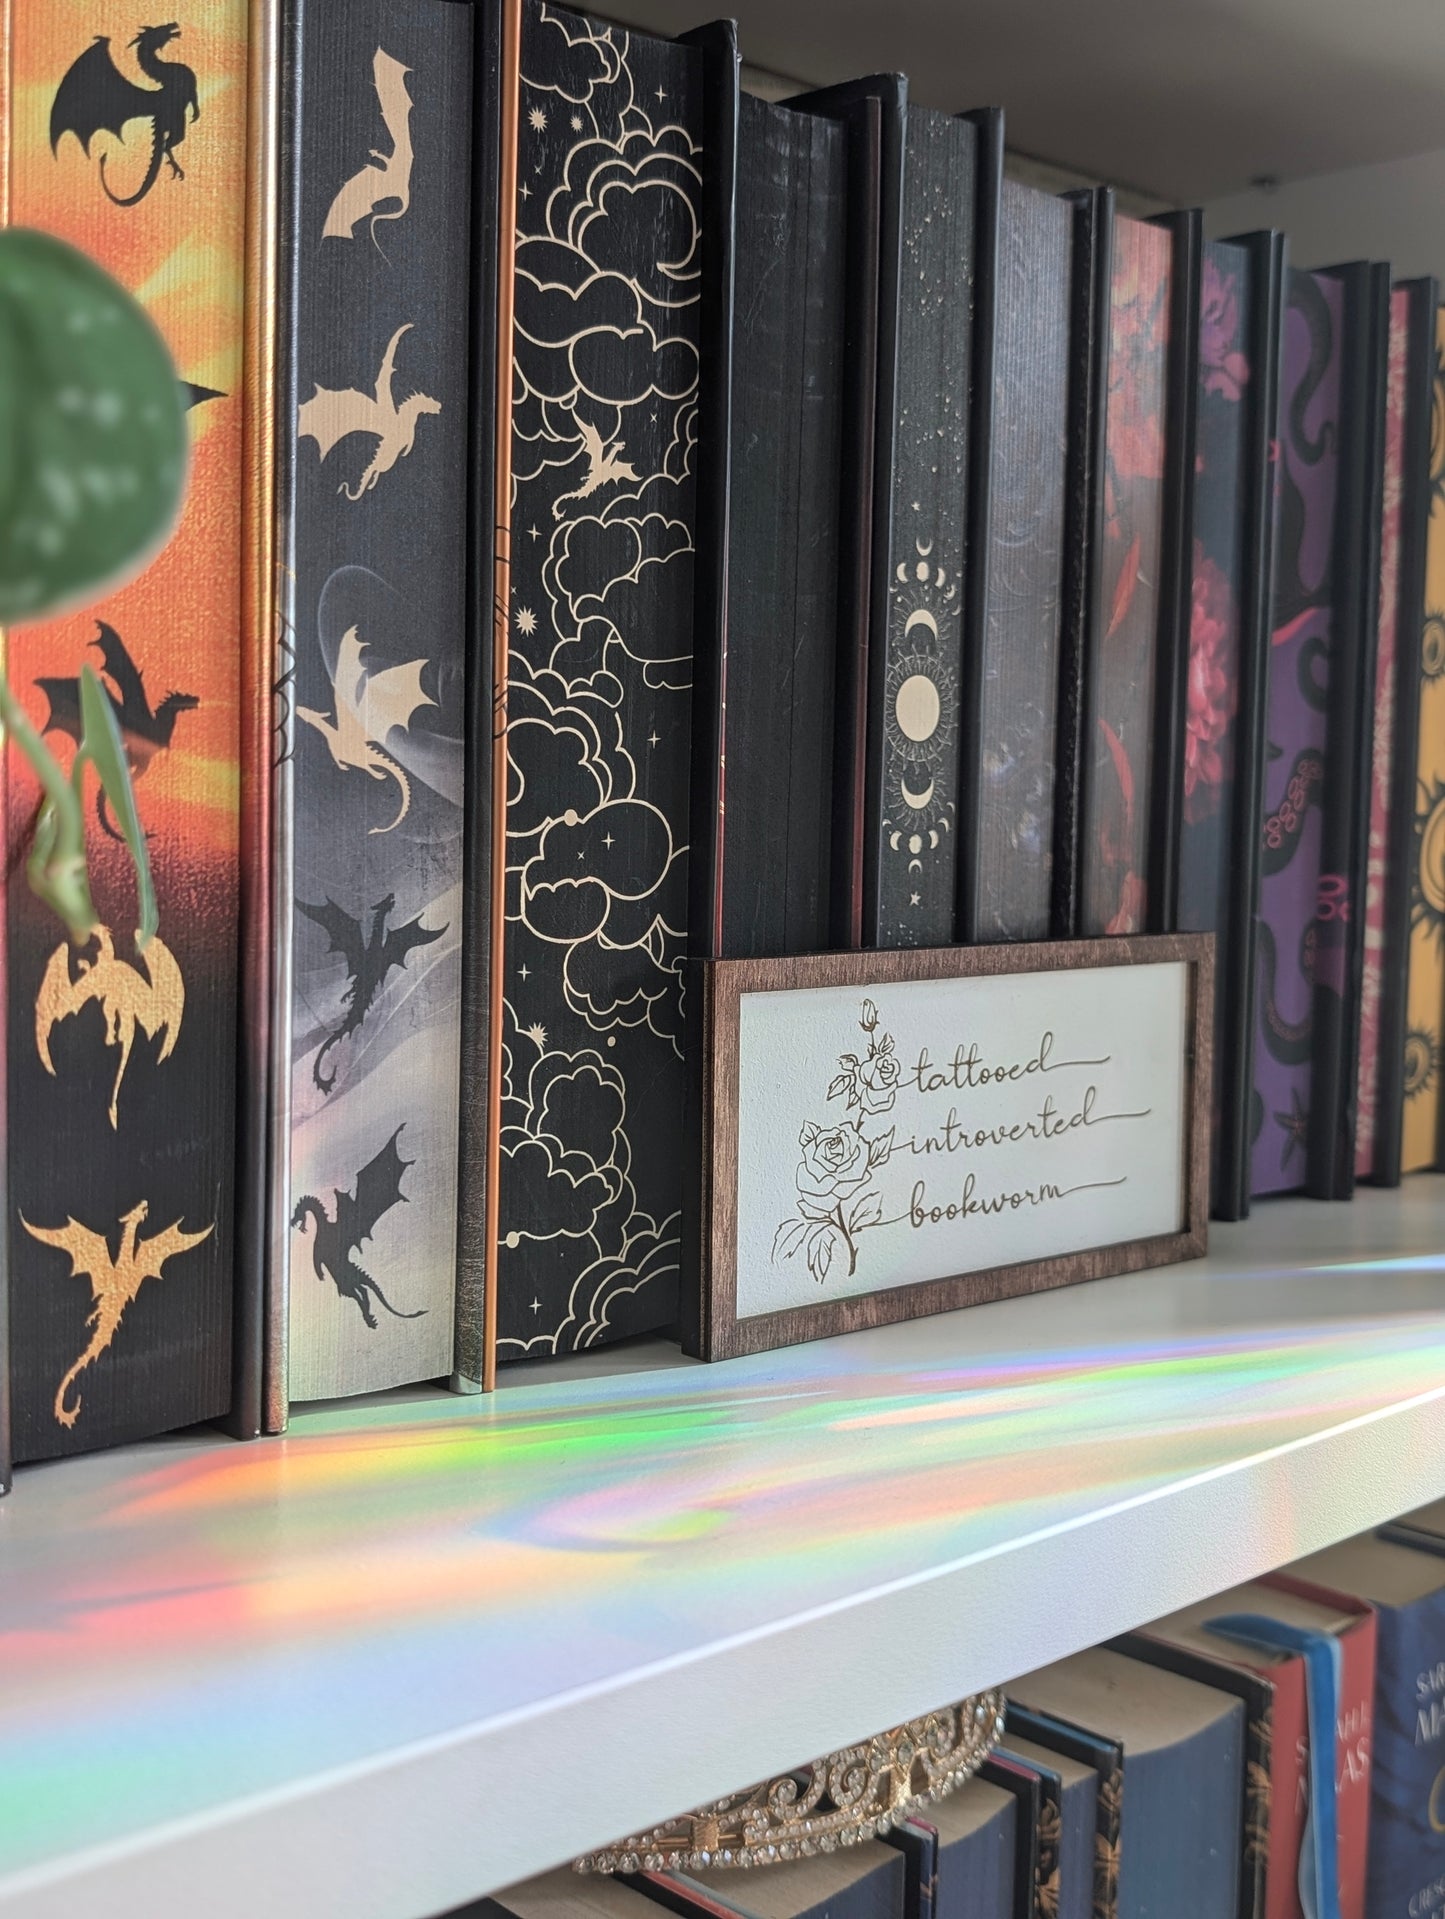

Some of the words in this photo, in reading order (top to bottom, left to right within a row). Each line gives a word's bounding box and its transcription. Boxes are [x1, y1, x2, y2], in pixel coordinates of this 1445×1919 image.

[902, 1030, 1111, 1093] tattooed
[905, 1085, 1152, 1155] introverted
[905, 1172, 1128, 1228] bookworm
